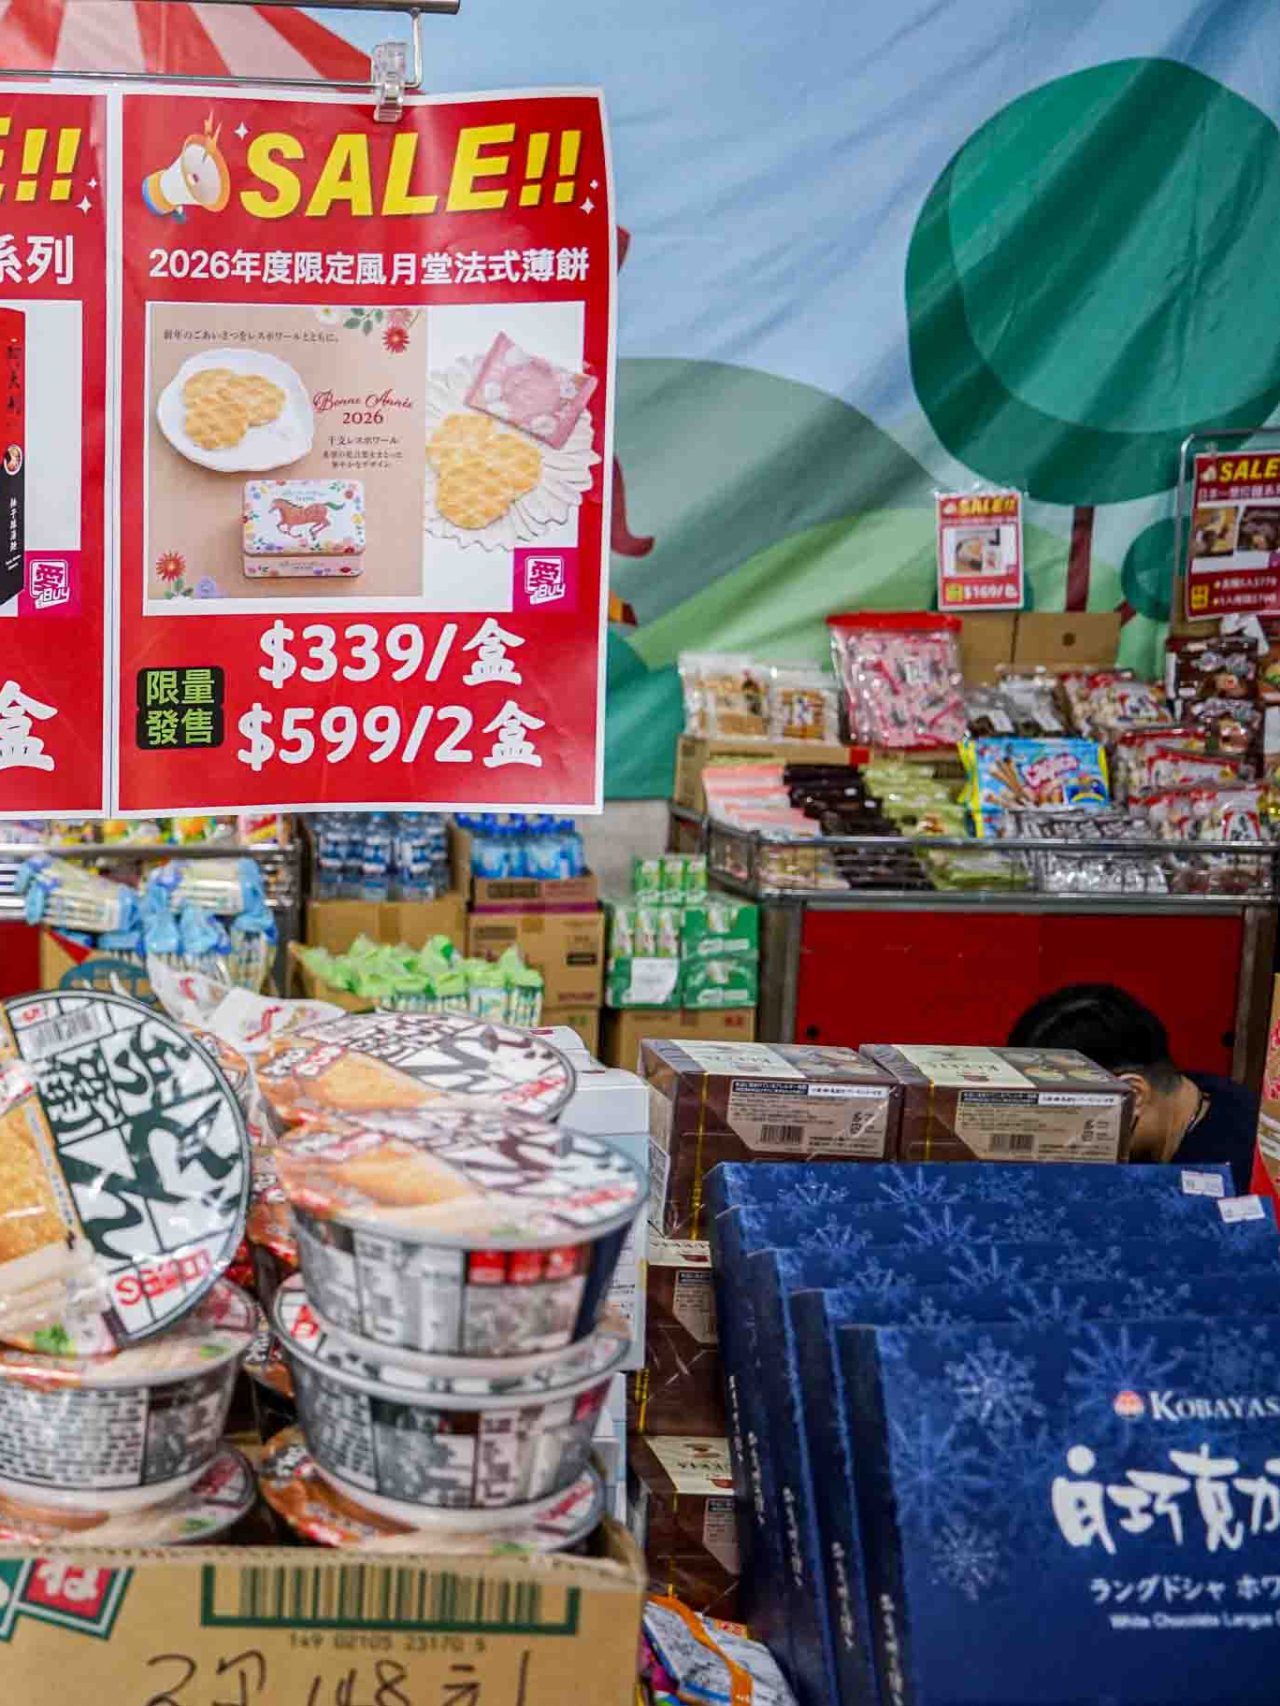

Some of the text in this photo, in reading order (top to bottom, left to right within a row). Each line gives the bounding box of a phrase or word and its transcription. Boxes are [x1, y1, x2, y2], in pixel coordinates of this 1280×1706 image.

[240, 122, 582, 219] SALE!!
[148, 246, 590, 287] 2026年度限定風月堂法式薄餅
[342, 409, 384, 425] 2026
[258, 618, 526, 689] $339/盒
[144, 670, 216, 706] 限量
[144, 708, 216, 747] 發售
[237, 700, 546, 772] $599/2盒
[1089, 1574, 1227, 1605] ラングドシャ
